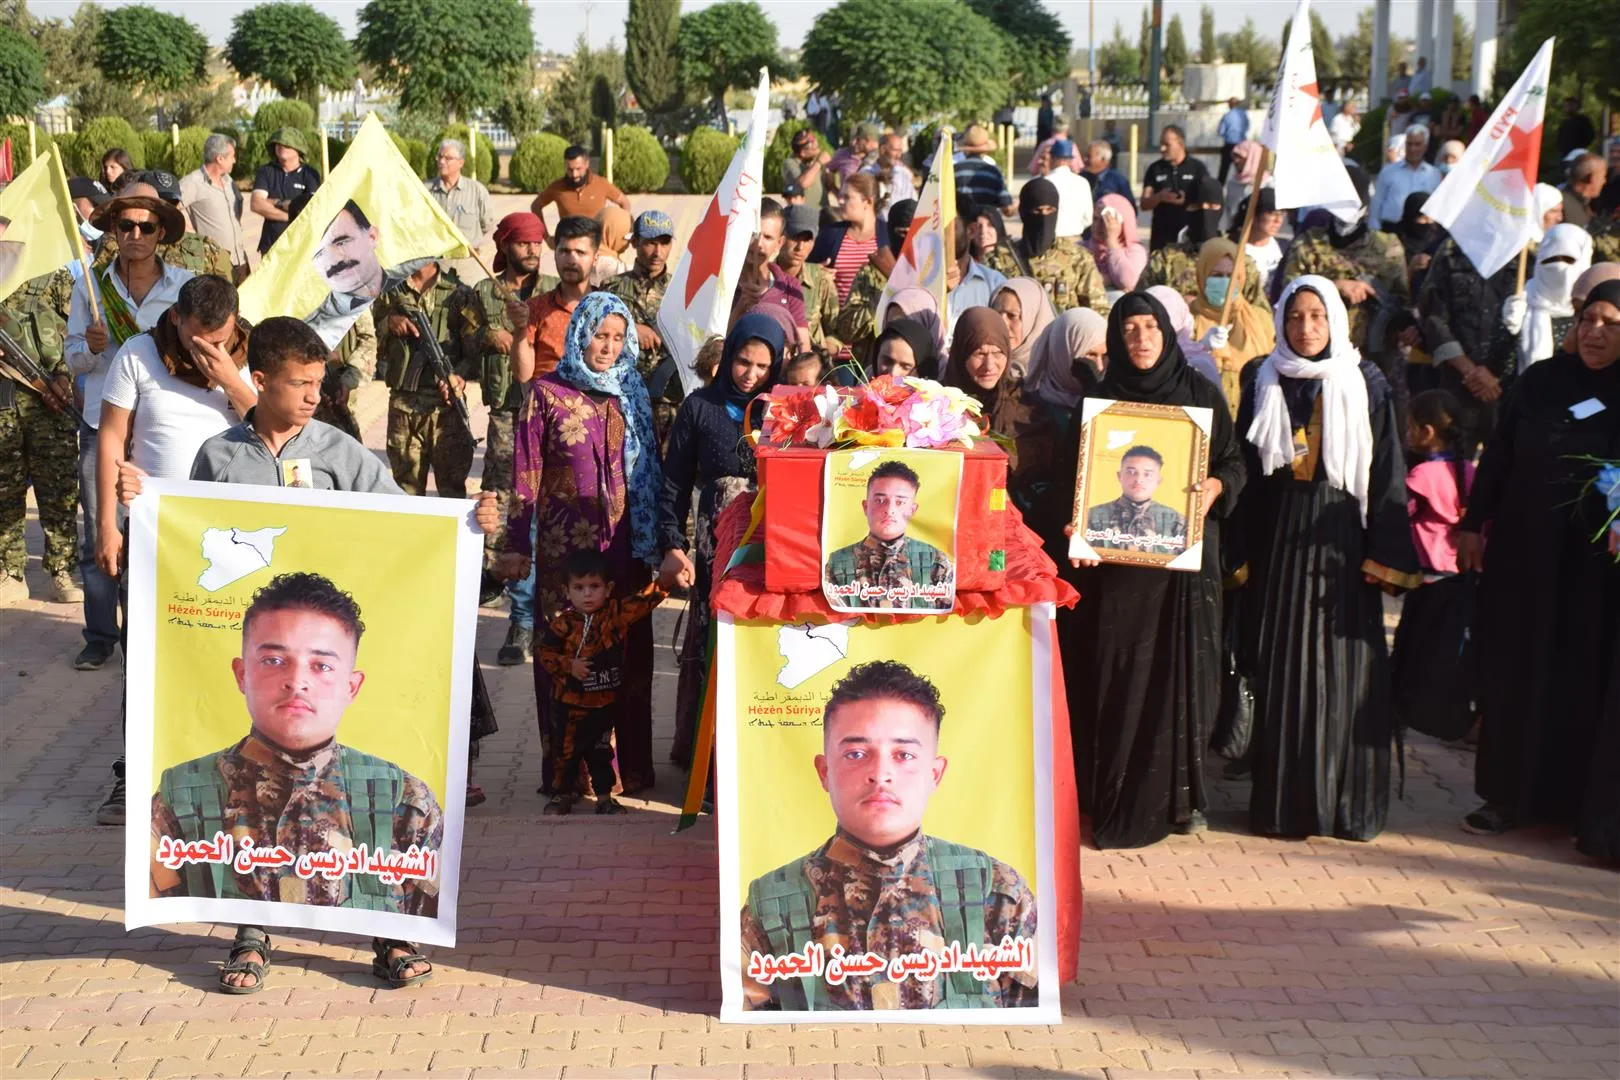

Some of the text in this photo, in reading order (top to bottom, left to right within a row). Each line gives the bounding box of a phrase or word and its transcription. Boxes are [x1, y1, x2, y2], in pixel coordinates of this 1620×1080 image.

[828, 581, 860, 598] الحمود
[860, 583, 887, 600] حسن
[168, 604, 241, 620] Hêzên Sûriya
[748, 704, 821, 717] Hêzên Sûriya
[158, 835, 233, 867] الحمود
[236, 838, 293, 872] حسن
[367, 846, 437, 882] الشهيد
[749, 944, 822, 981] الحمود
[827, 945, 885, 982] حسن
[960, 938, 1032, 978] الشهيد
